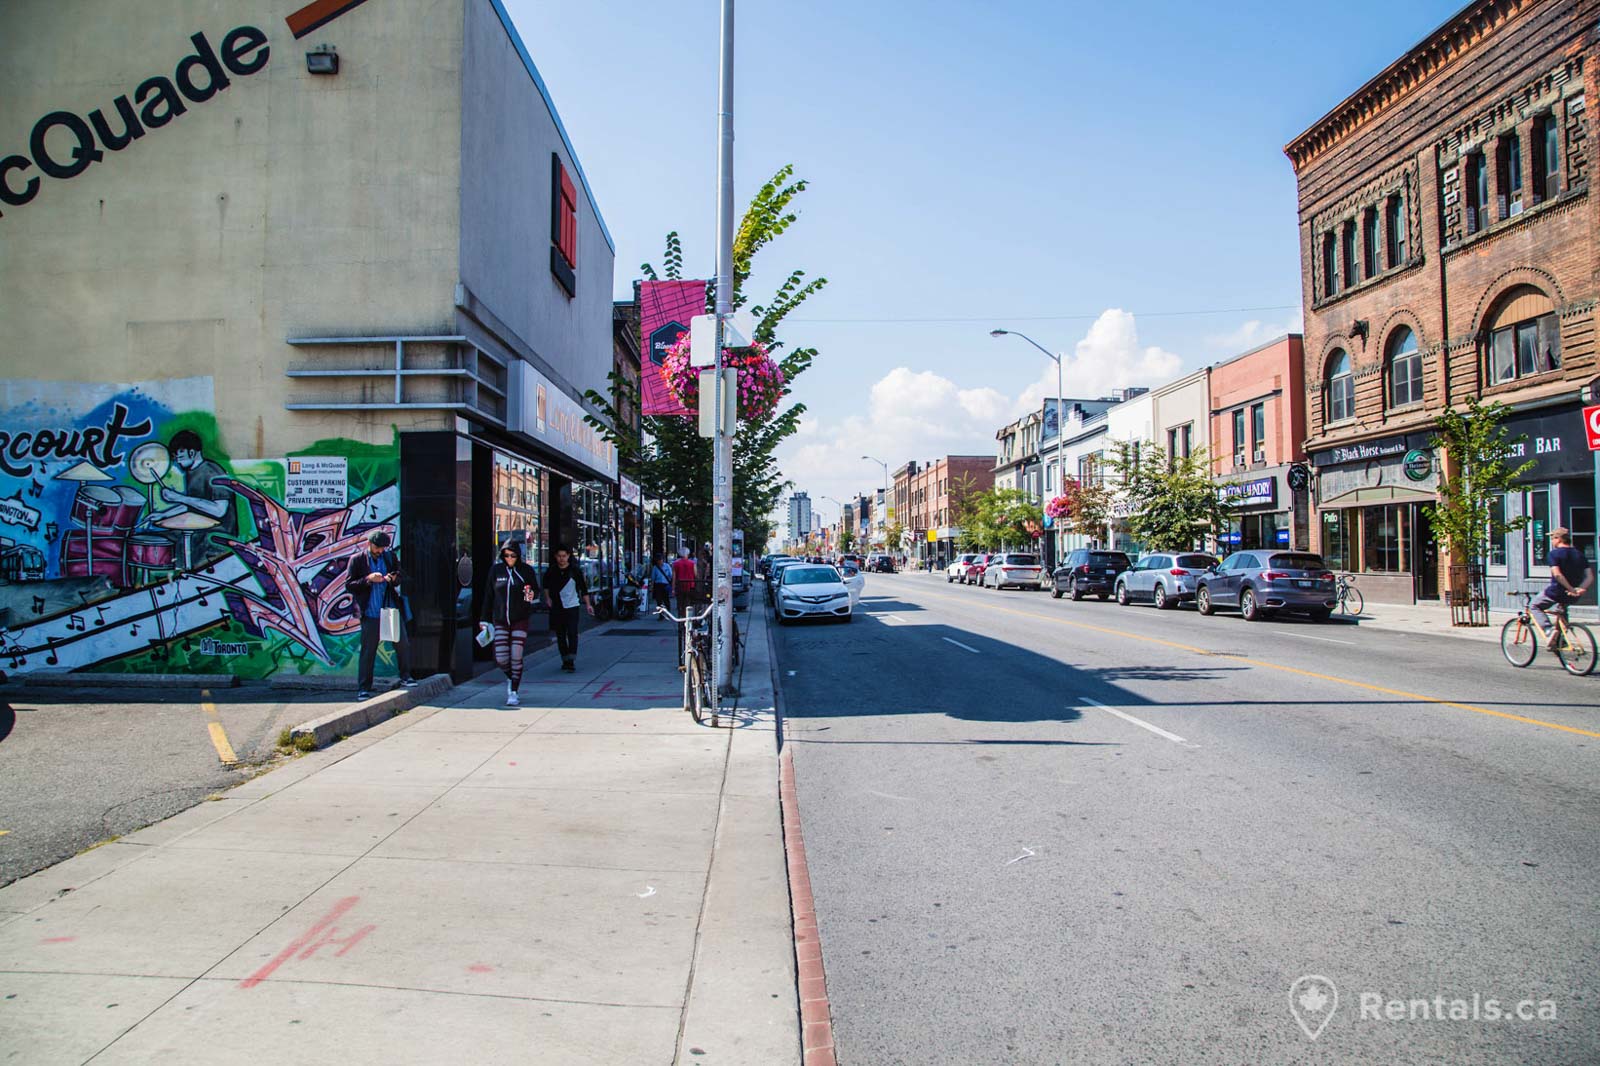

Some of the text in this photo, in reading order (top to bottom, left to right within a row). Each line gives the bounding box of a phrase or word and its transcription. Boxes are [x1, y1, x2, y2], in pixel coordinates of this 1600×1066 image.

[0, 25, 271, 218] cQuade
[1340, 446, 1359, 461] Black
[1359, 444, 1379, 458] Horse
[1536, 437, 1560, 454] BAR
